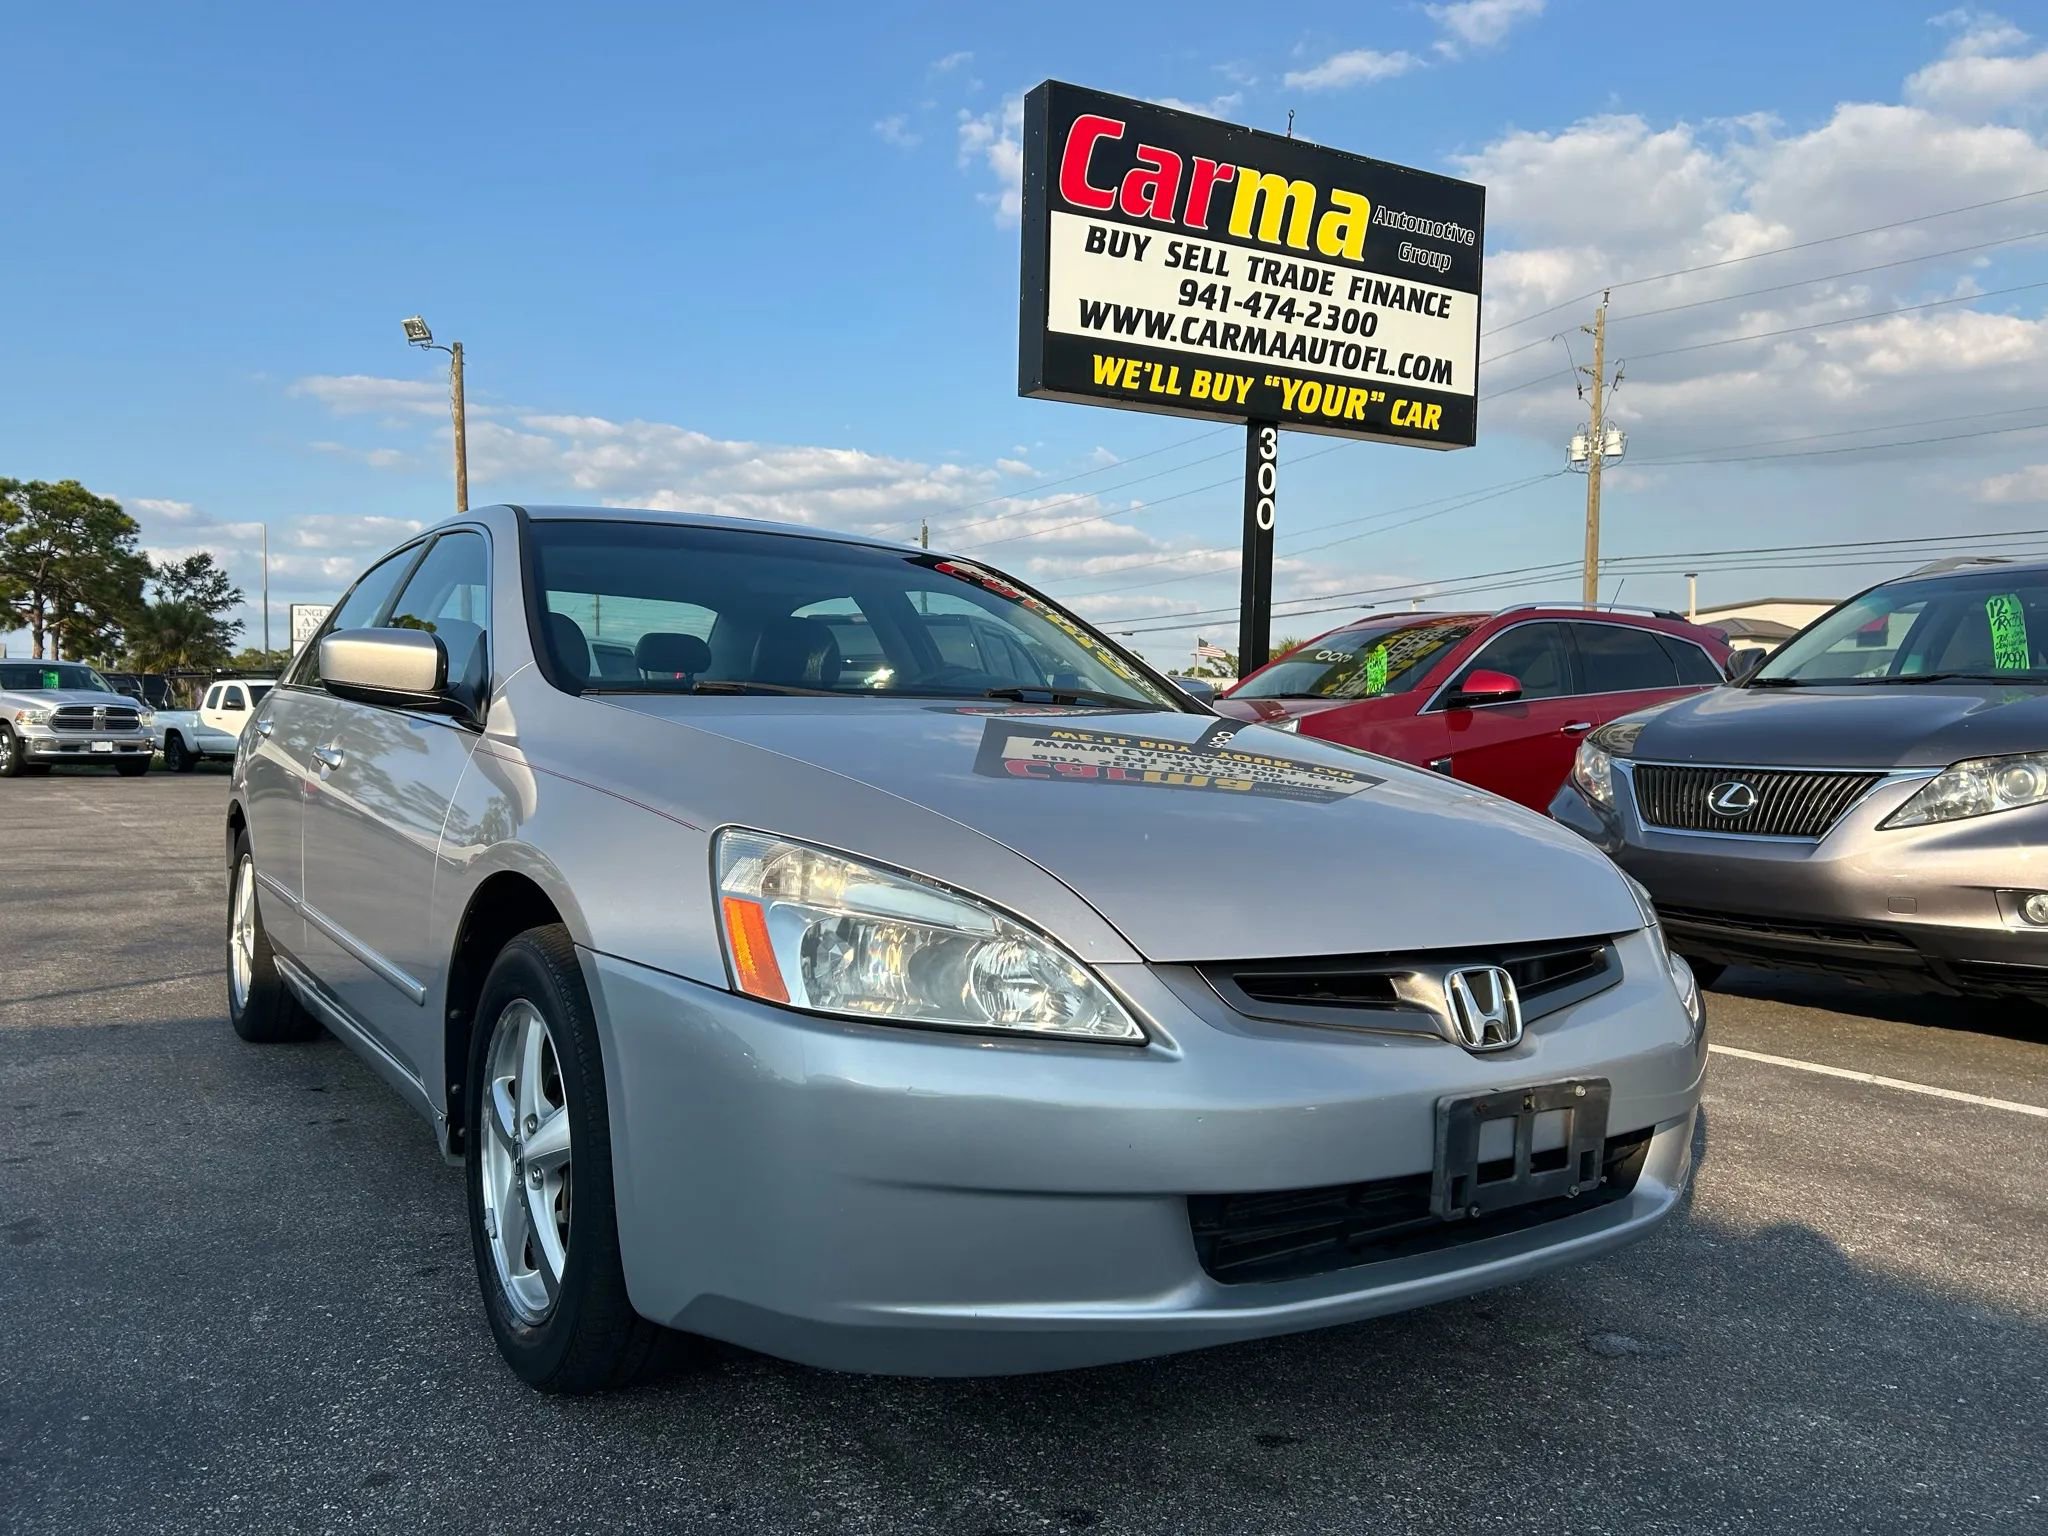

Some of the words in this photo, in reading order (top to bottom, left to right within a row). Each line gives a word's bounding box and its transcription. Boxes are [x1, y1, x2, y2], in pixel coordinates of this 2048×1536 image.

[1059, 113, 1371, 262] Carma
[1373, 204, 1476, 246] Automotive
[1084, 224, 1152, 262] BUY
[1164, 240, 1230, 278] SELL
[1247, 255, 1336, 297] TRADE
[1347, 275, 1453, 320] FINANCE
[1398, 241, 1452, 274] Group
[1079, 298, 1454, 386] WWW.CARMAAUTOFL.COM
[1178, 278, 1378, 338] 941-474-2300
[1093, 354, 1182, 396] WE'LL
[1189, 368, 1255, 405] BUY
[1264, 374, 1386, 421] "YOUR"
[1390, 399, 1443, 431] CAR
[1256, 427, 1278, 531] 300
